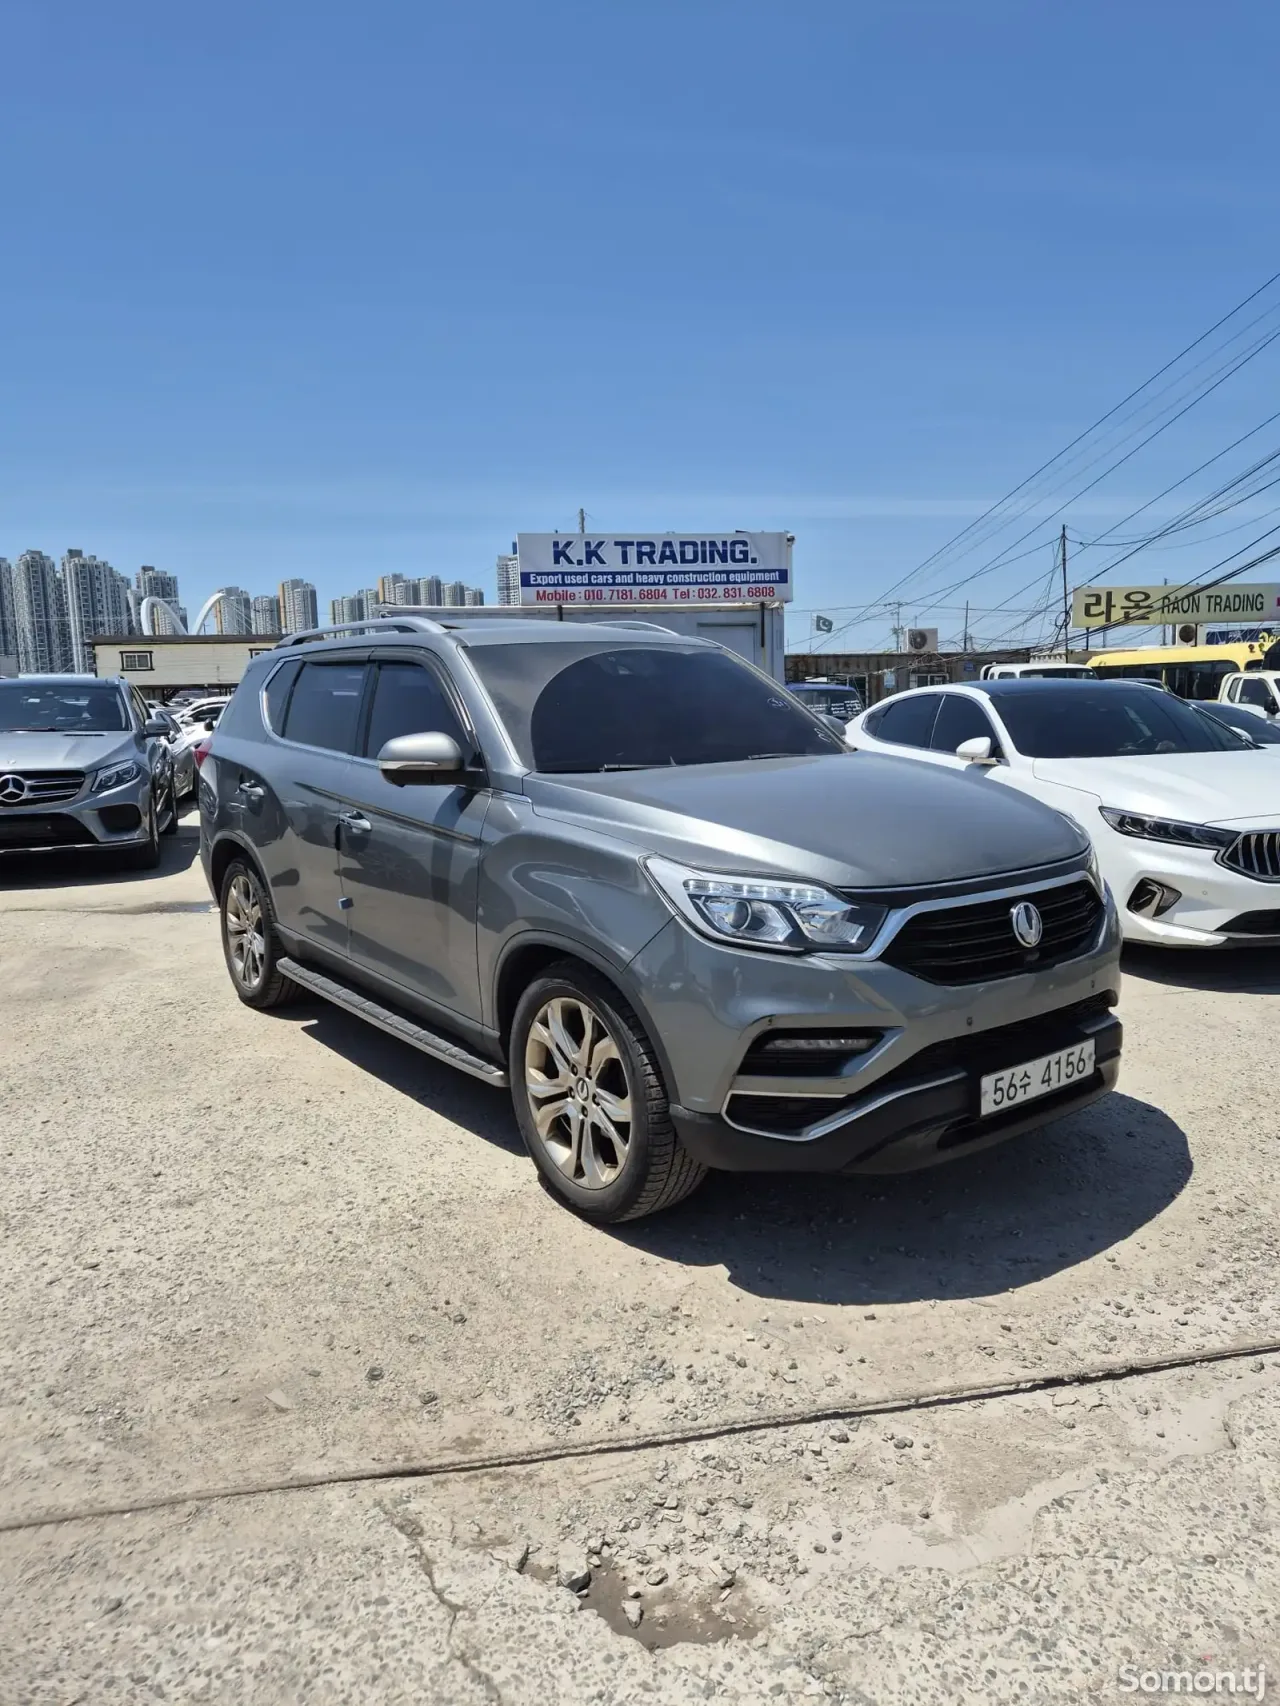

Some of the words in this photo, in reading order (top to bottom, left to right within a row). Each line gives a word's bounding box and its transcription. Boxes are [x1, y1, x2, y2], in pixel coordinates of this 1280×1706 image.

[552, 540, 607, 566] K.K
[613, 539, 757, 565] TRADING.
[529, 573, 562, 585] Export
[564, 574, 589, 584] used
[591, 574, 613, 584] cars
[615, 573, 634, 583] and
[635, 572, 664, 584] heavy
[666, 571, 727, 583] construction
[729, 570, 780, 583] equipment
[1161, 595, 1200, 614] RAON
[1205, 593, 1265, 613] TRADING
[993, 1070, 1031, 1106] 56수
[1041, 1047, 1086, 1087] 4156
